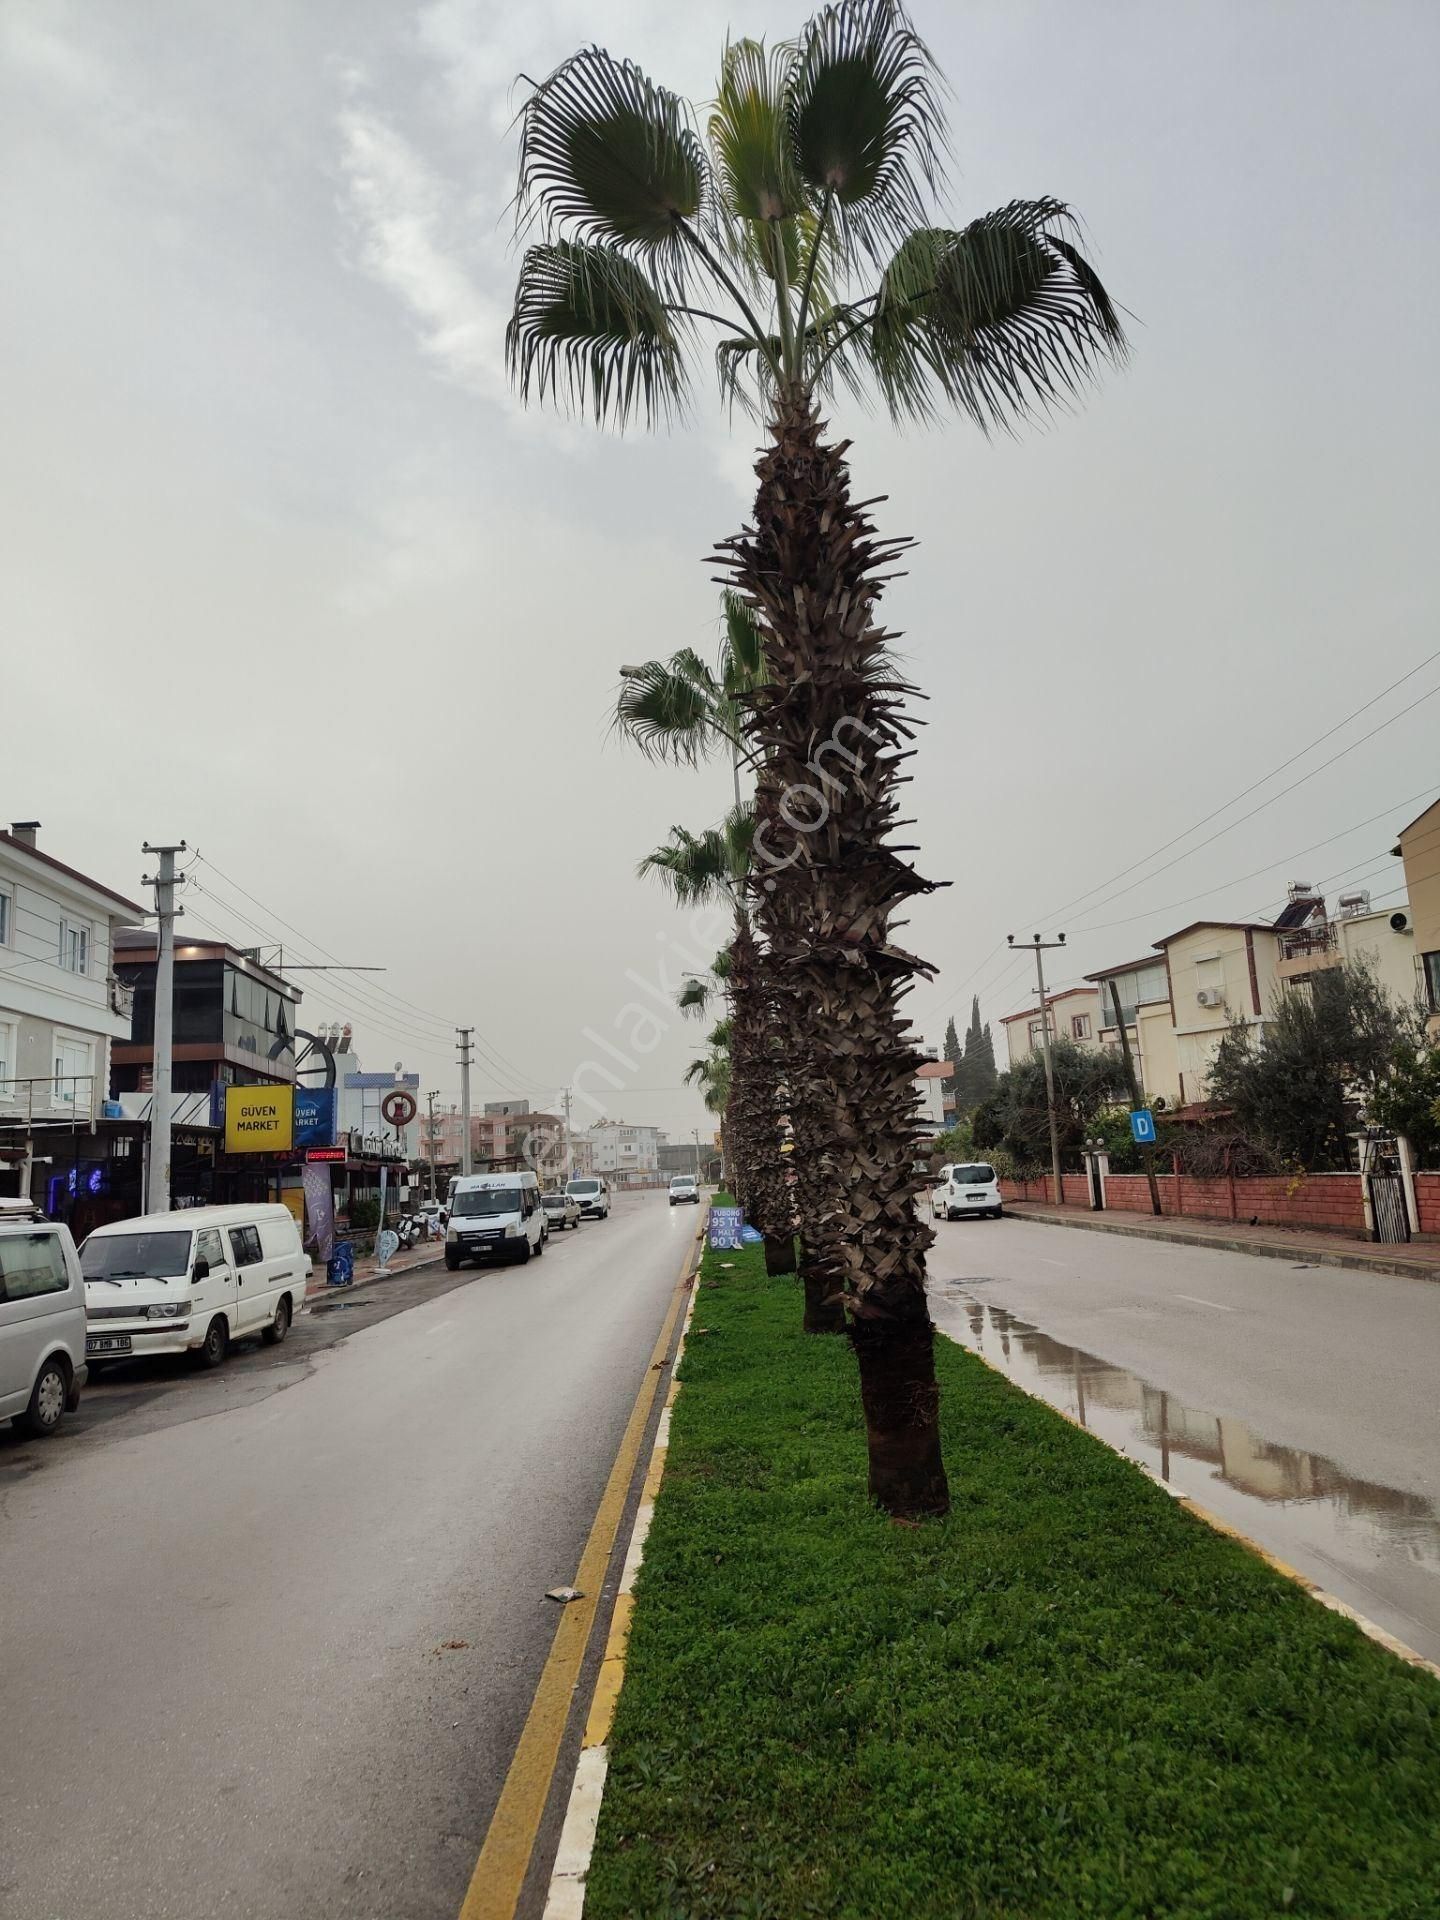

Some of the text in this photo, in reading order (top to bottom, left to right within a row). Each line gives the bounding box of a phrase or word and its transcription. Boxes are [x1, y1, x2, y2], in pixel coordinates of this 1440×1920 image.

[240, 1104, 276, 1117] GÜVEN
[295, 1107, 317, 1117] ÜVEN
[236, 1119, 280, 1132] MARKET
[1136, 1117, 1149, 1136] D
[713, 1209, 740, 1217] TUBORG
[712, 1217, 740, 1227] 95 TL
[711, 1236, 739, 1247] 90 TL
[88, 1340, 97, 1350] 07
